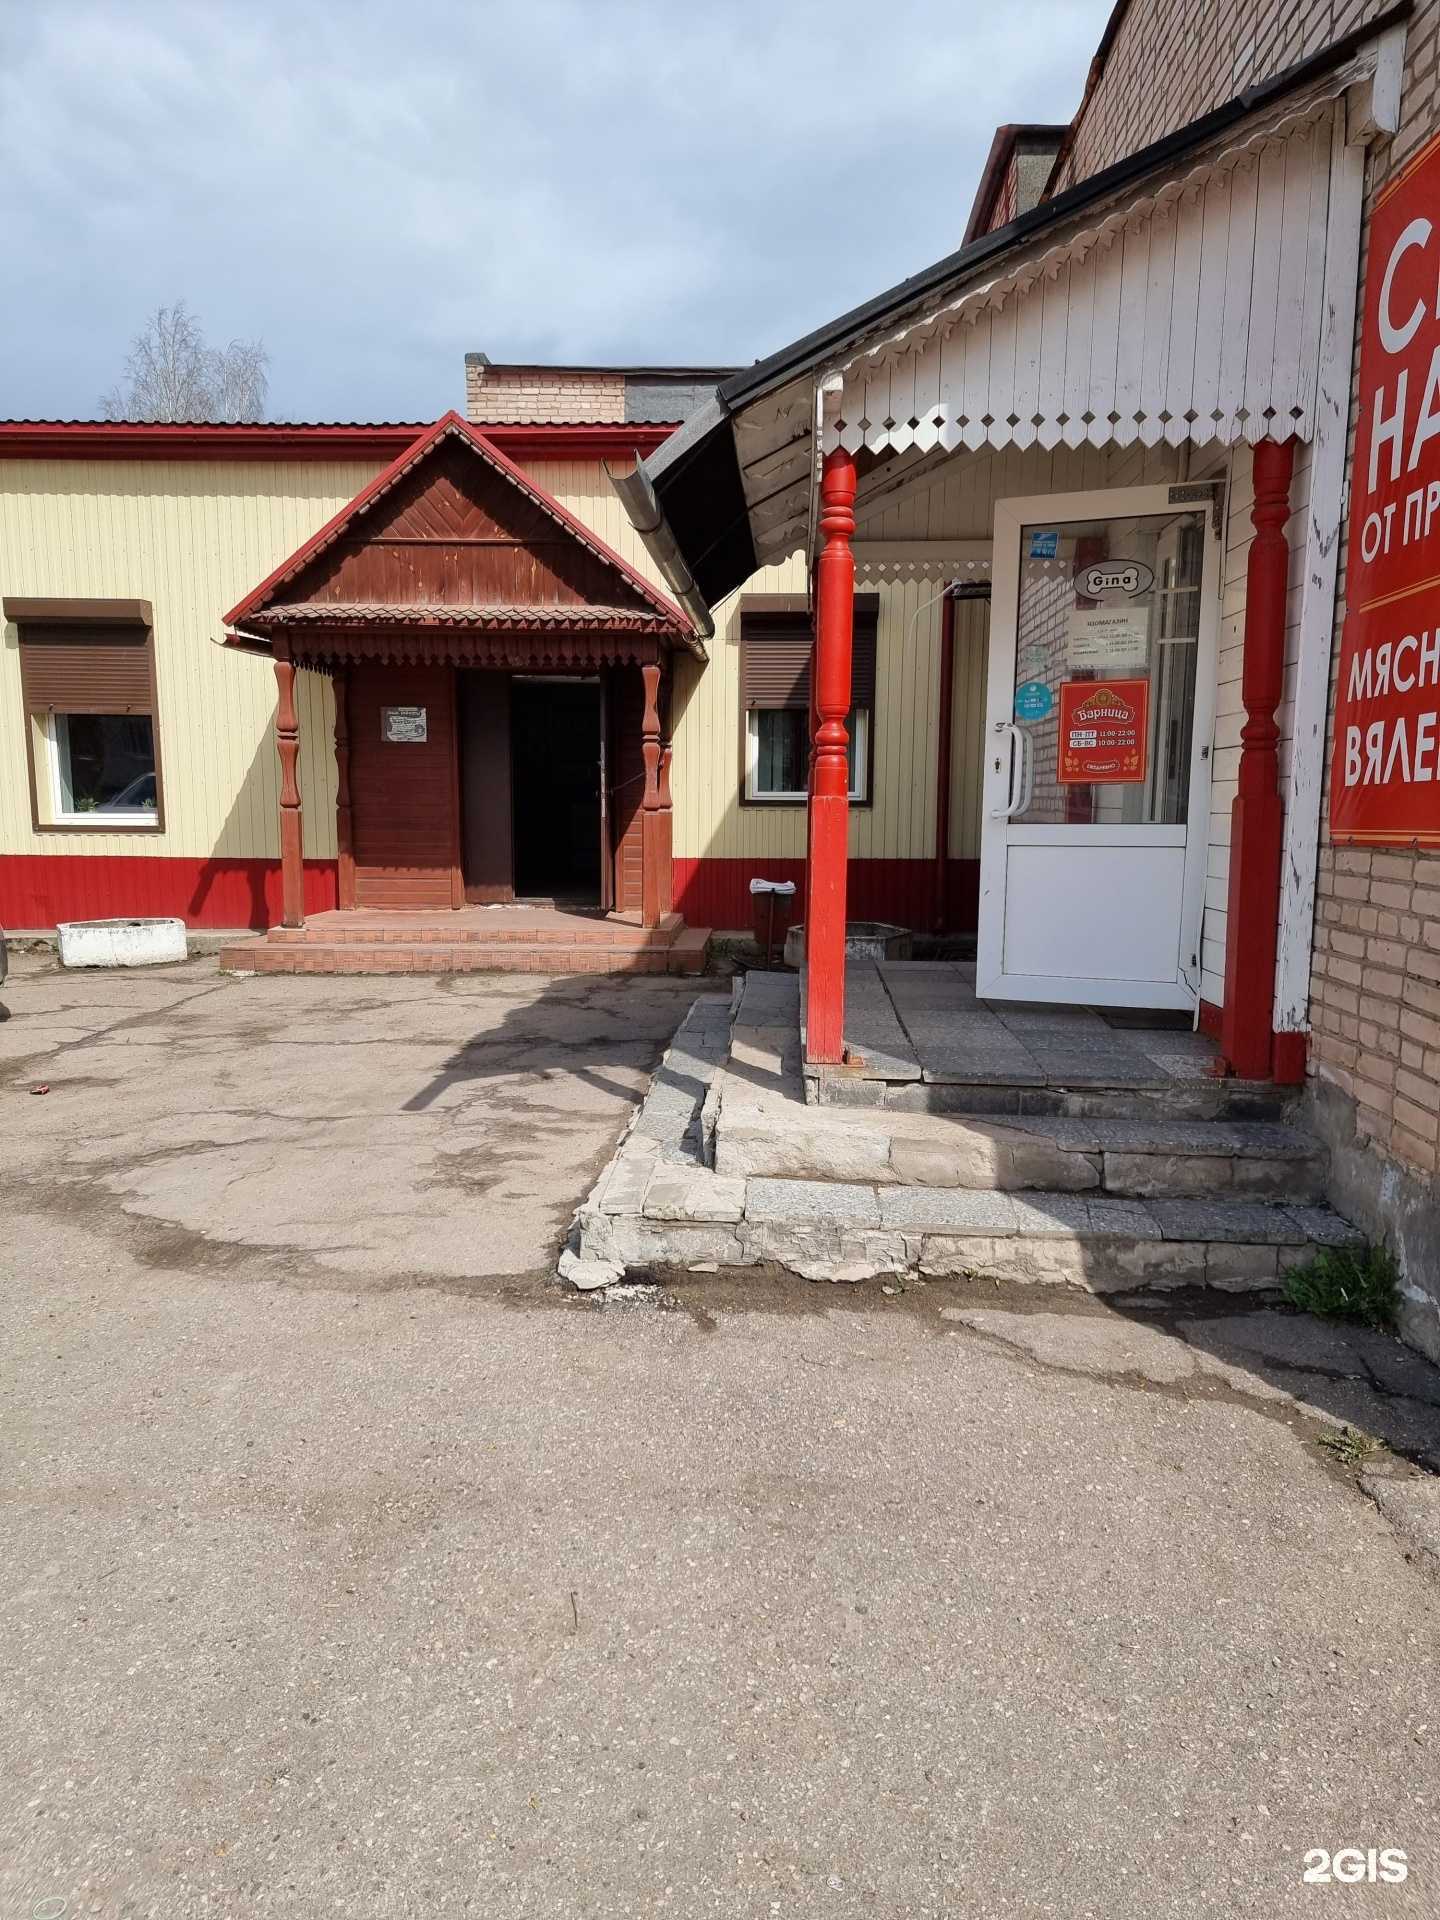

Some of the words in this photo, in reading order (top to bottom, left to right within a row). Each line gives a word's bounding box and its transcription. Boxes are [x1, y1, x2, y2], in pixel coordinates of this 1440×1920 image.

[1379, 218, 1440, 354] С
[1361, 503, 1396, 563] ОТ
[1093, 576, 1131, 587] Gina
[1077, 708, 1129, 721] Барница
[1345, 711, 1440, 787] ВЯЛЕ
